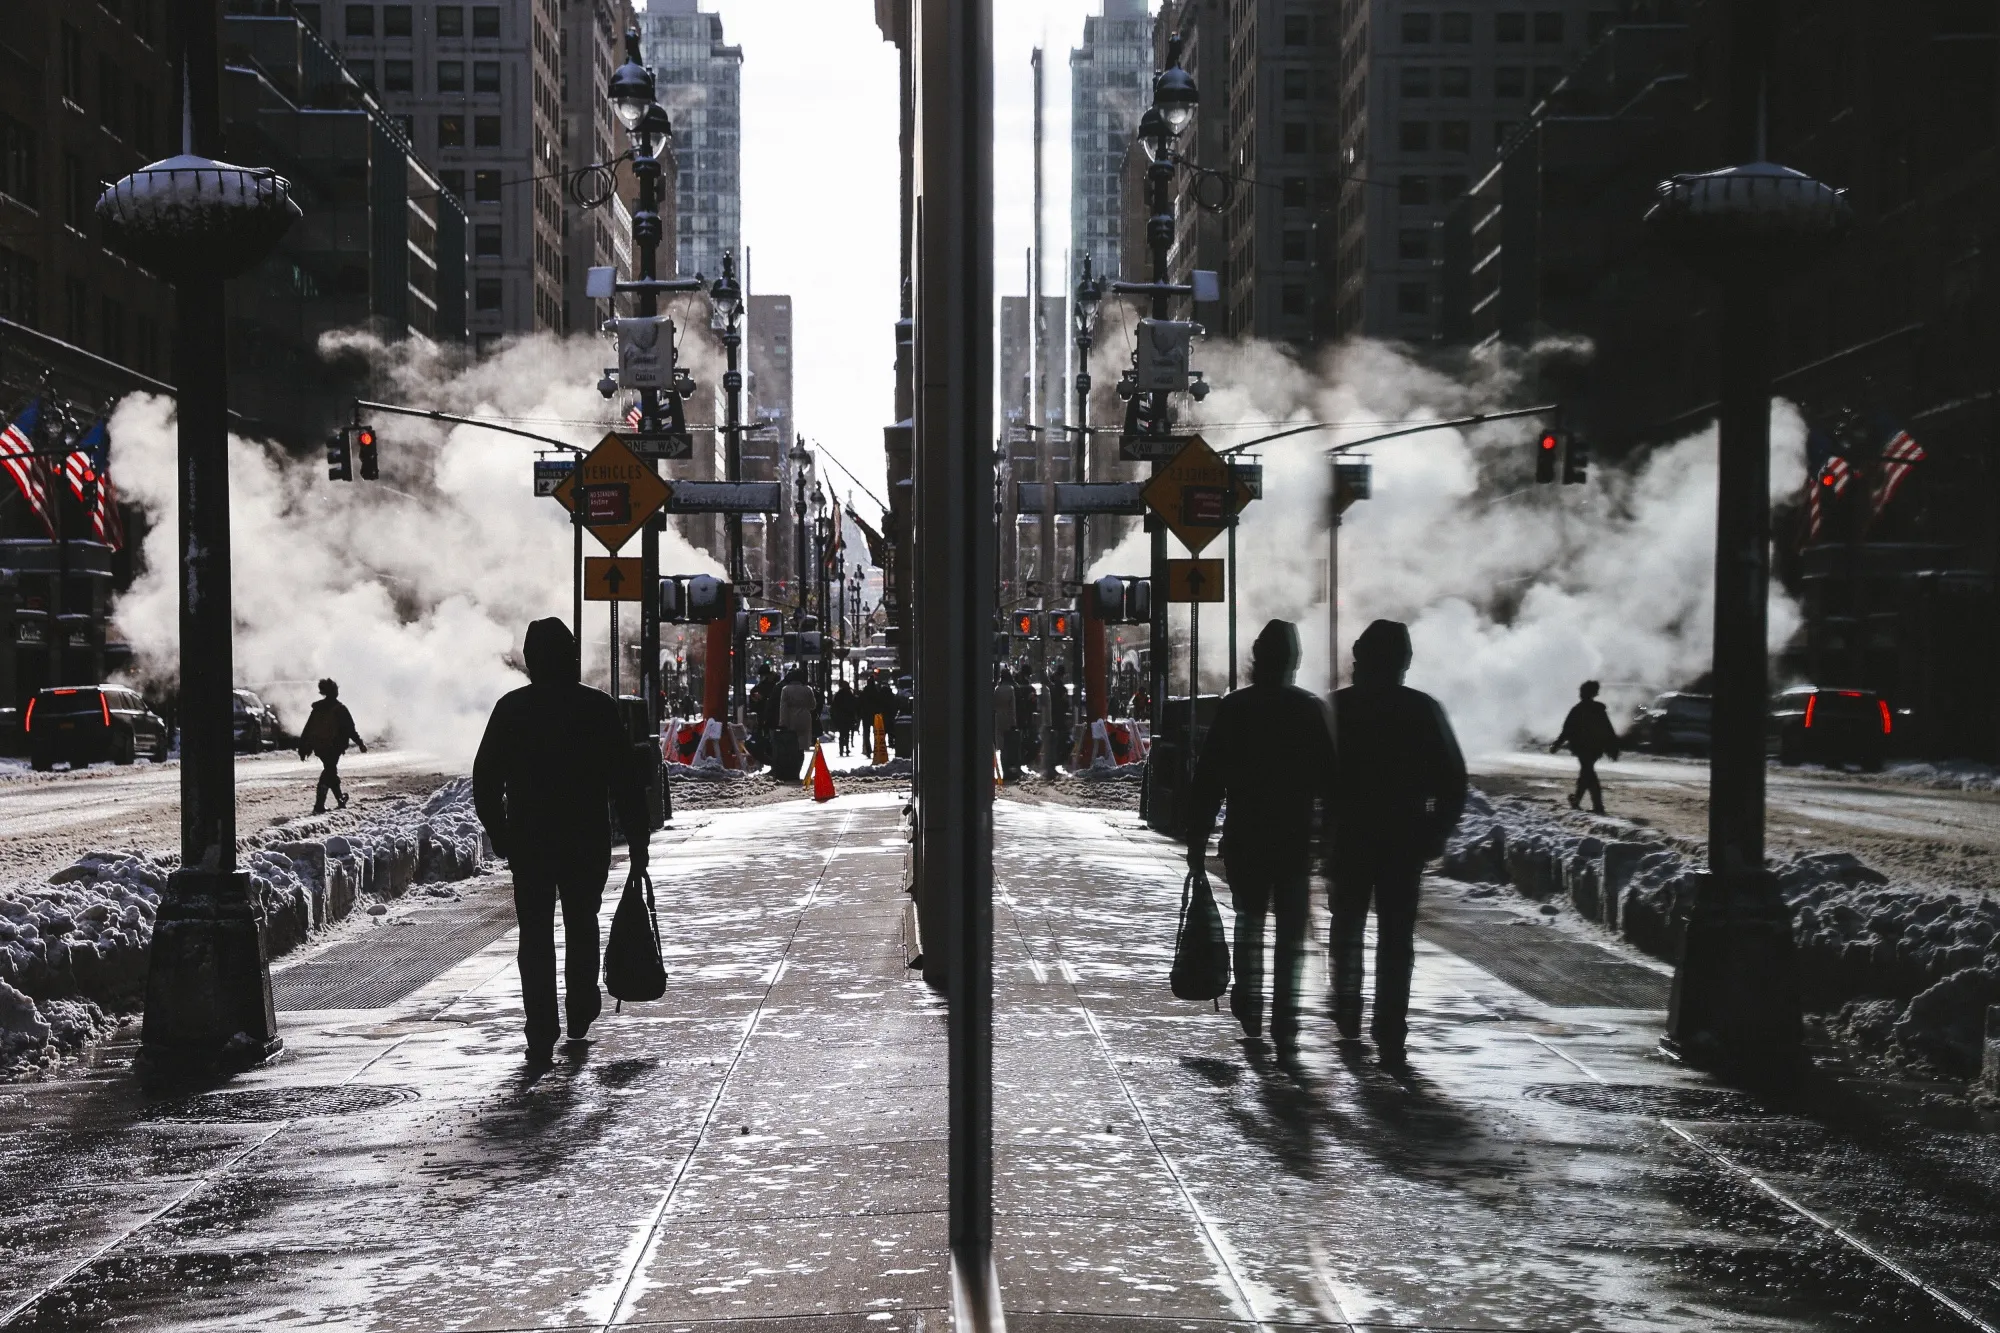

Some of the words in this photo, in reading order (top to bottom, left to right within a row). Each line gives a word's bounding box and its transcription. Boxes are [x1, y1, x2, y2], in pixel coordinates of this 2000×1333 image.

[658, 440, 680, 451] WAY
[584, 464, 643, 480] VEHICLES
[597, 490, 618, 498] STANDING
[740, 585, 757, 593] WAY
